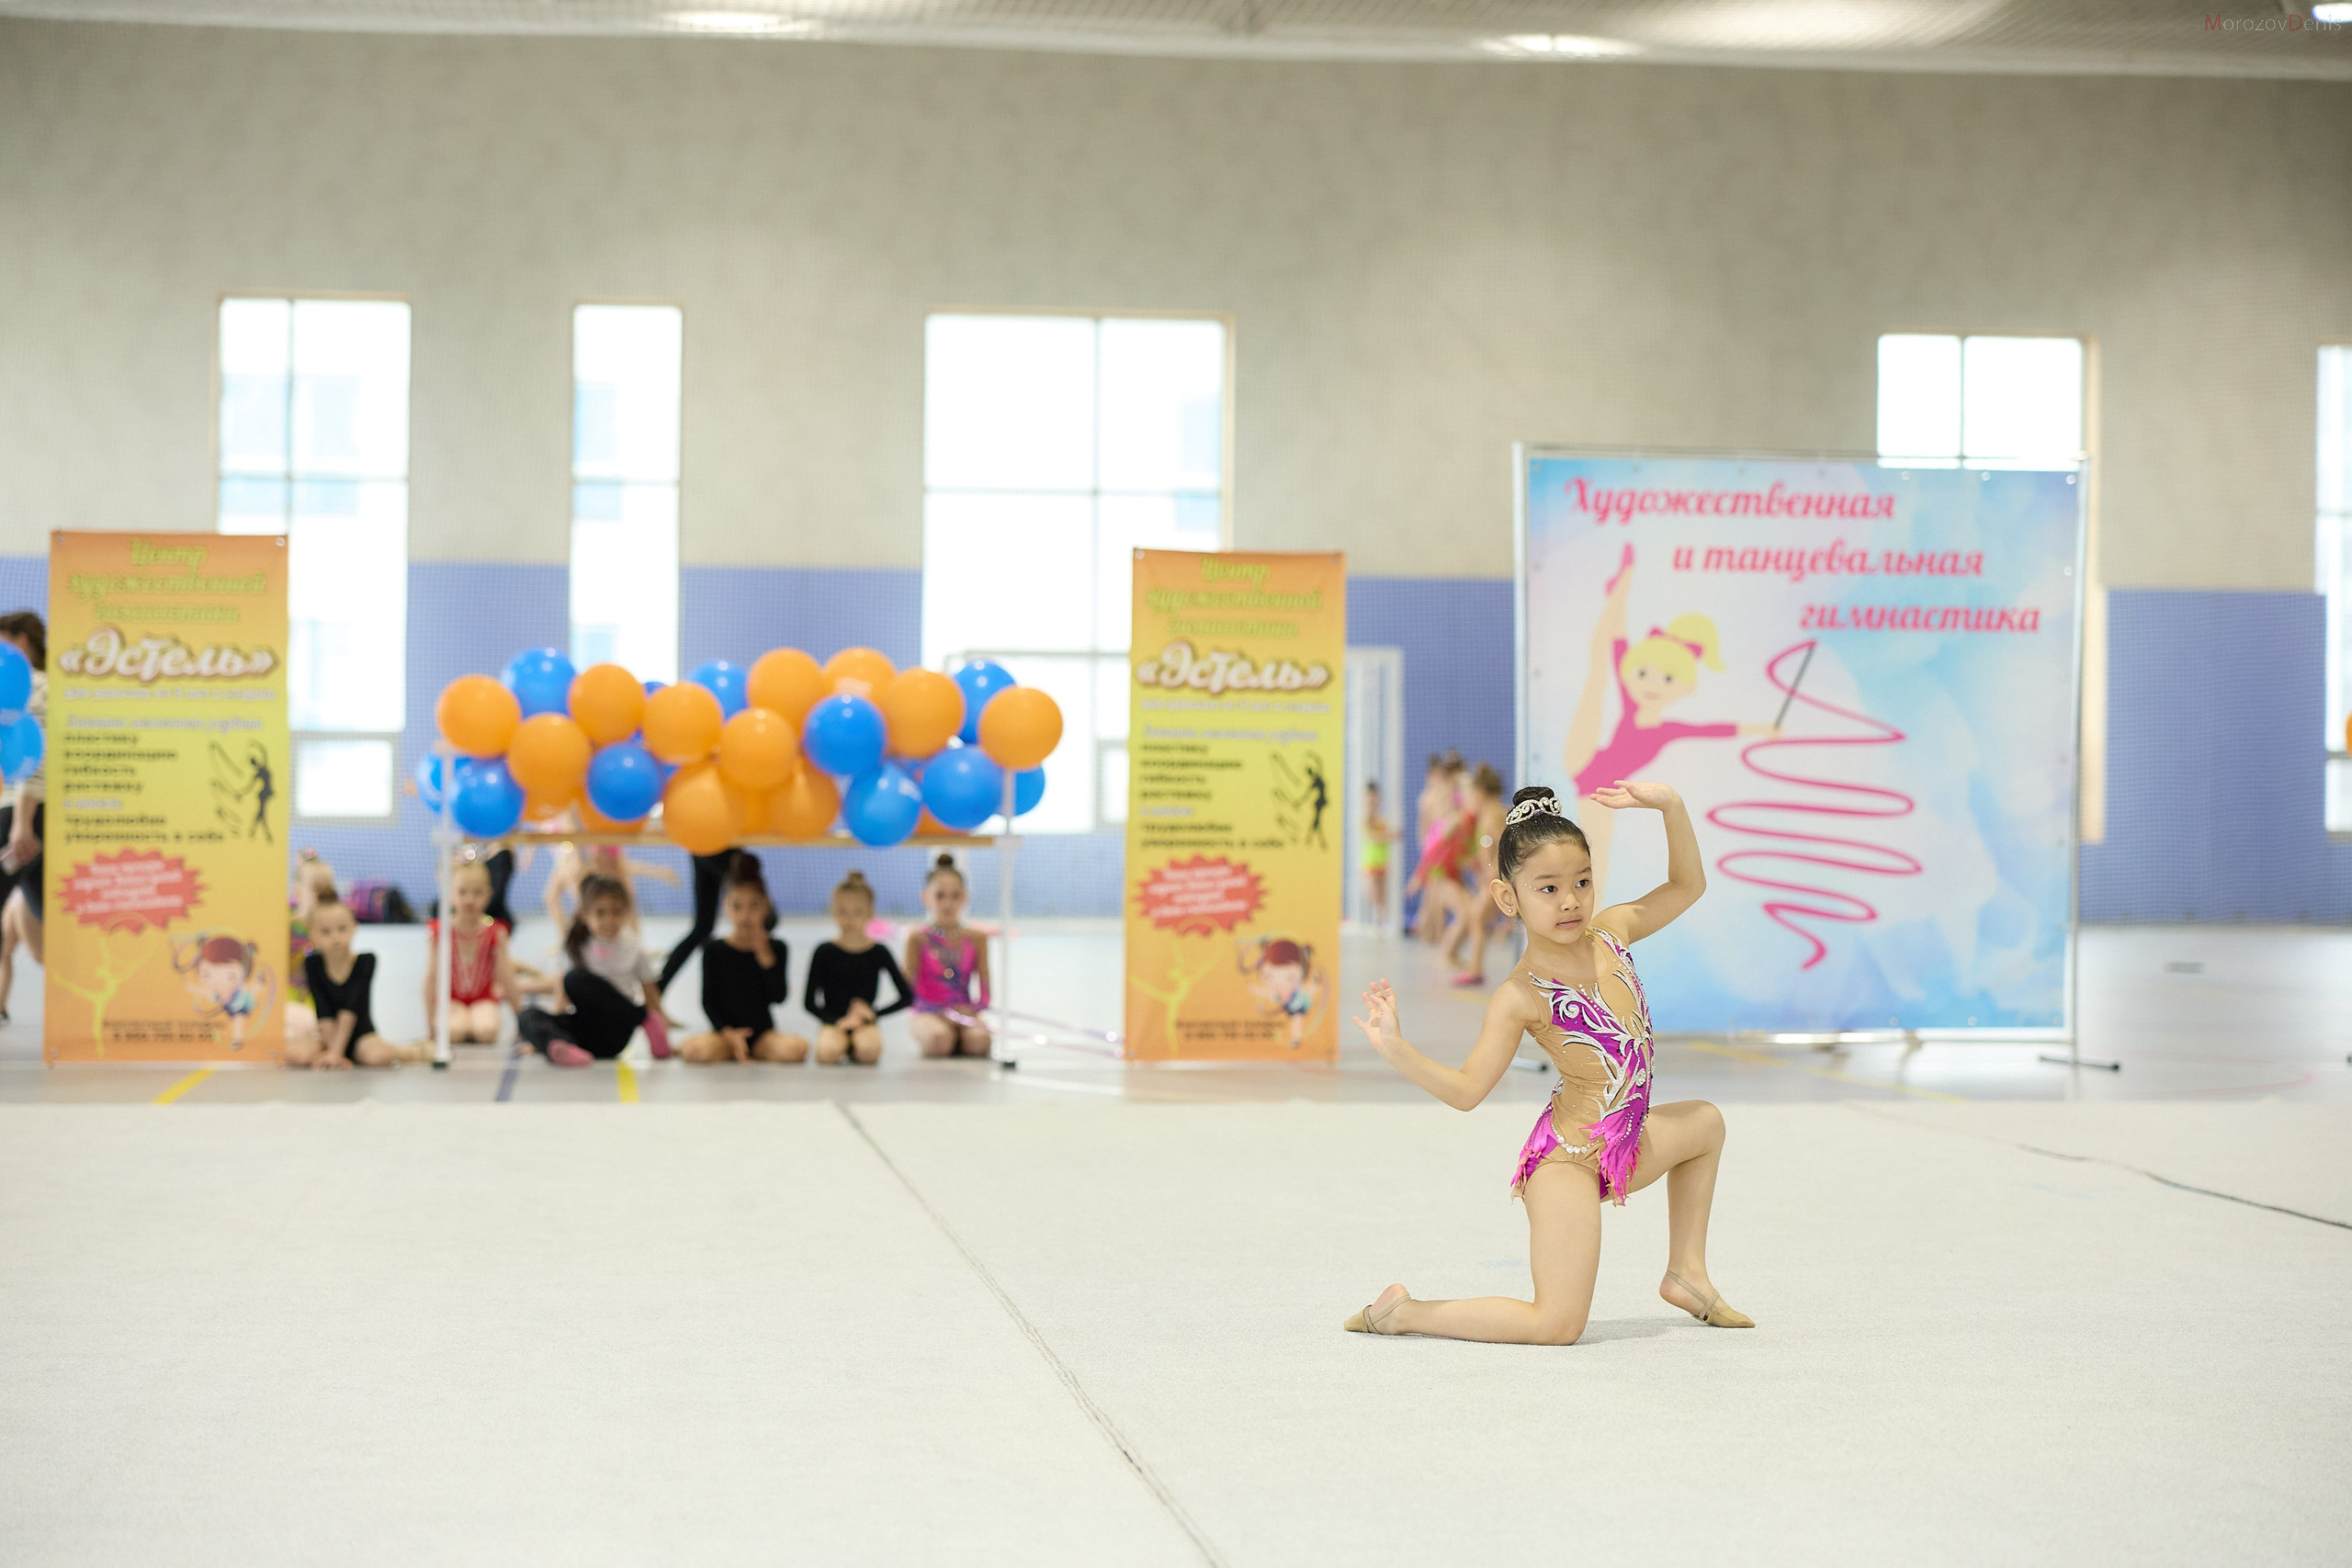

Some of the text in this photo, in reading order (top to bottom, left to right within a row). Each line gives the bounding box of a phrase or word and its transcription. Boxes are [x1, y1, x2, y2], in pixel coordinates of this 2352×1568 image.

[1564, 477, 1895, 525] Художественная
[130, 539, 208, 580] Центр
[1201, 556, 1270, 594] Центр
[1672, 538, 1984, 582] и танцевальная
[1799, 601, 2041, 634] гимнастика
[60, 626, 277, 682] «Эстель»
[1136, 640, 1330, 694] «Эстель»
